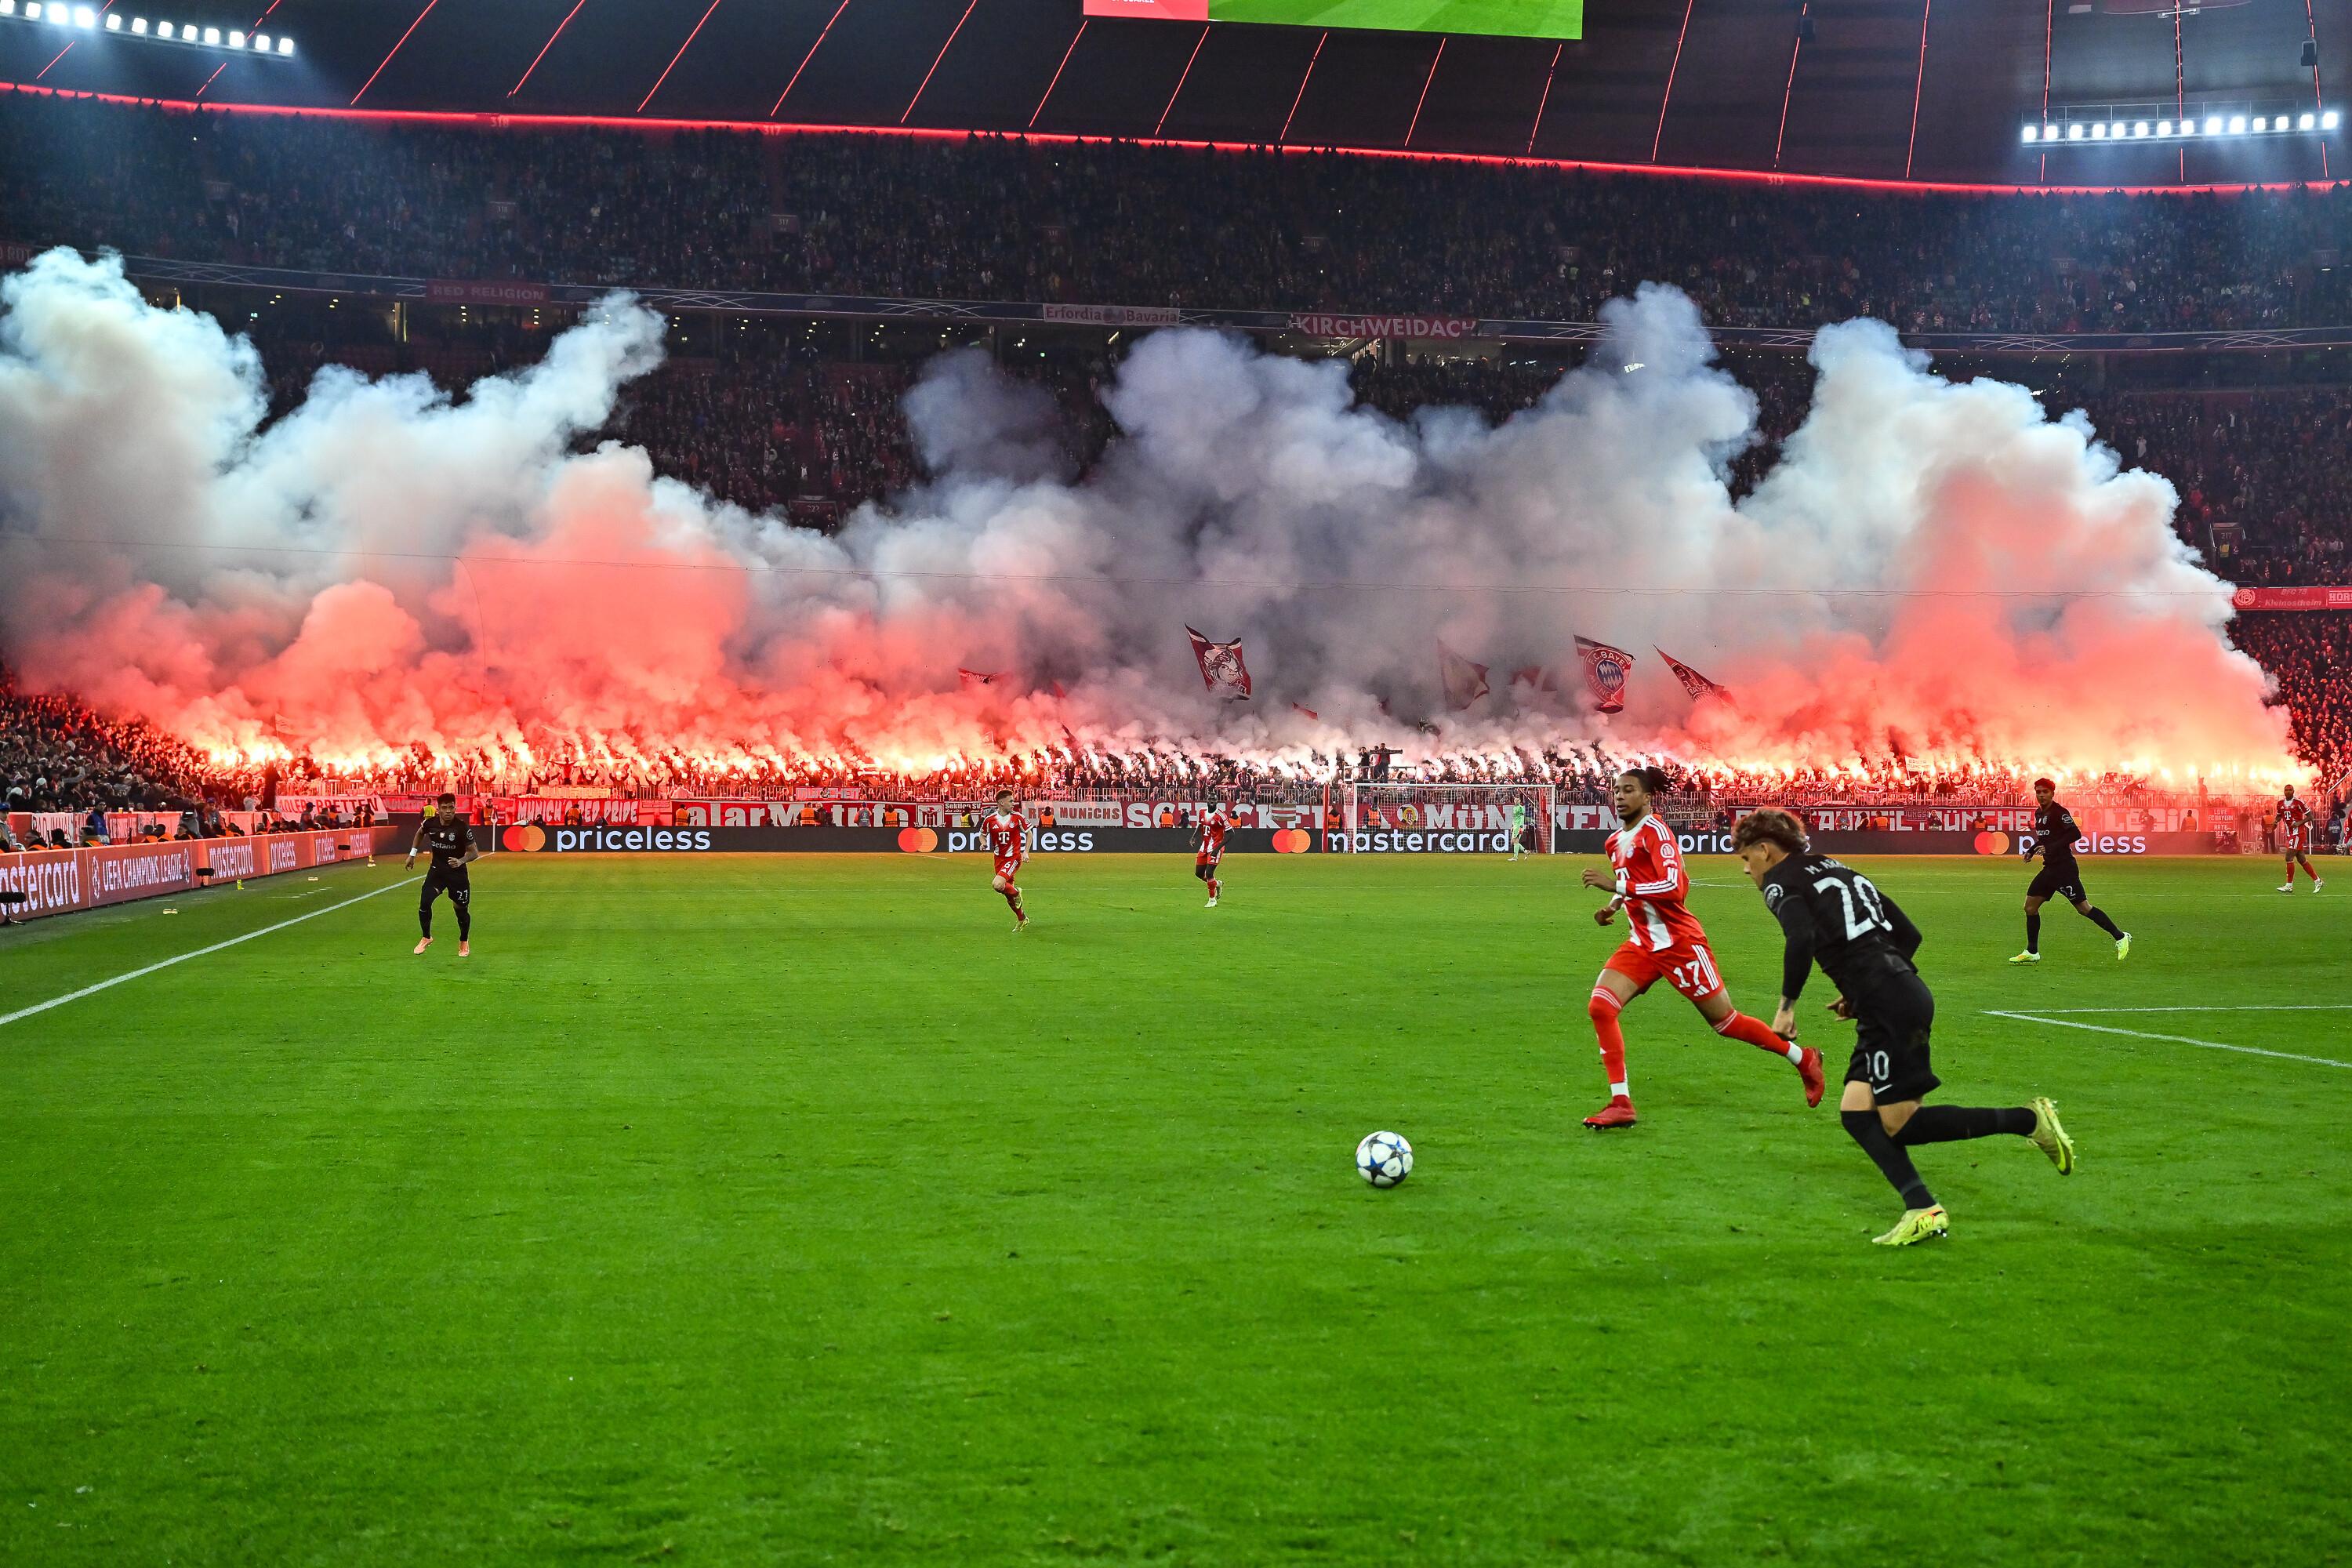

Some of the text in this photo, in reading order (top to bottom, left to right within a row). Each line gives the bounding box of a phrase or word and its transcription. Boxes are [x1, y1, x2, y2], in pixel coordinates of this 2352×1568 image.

[434, 285, 544, 300] RED RELIGION
[1045, 307, 1177, 323] Erfordia Bavaria
[2328, 593, 2352, 601] HOR
[316, 797, 379, 813] BRETTEN
[604, 800, 638, 823] PRIDE
[315, 833, 335, 866] priceless
[557, 826, 710, 852] priceless
[949, 828, 1094, 852] prieless
[1323, 829, 1509, 851] mastercard
[2019, 832, 2146, 855] peless
[209, 838, 255, 879] mastercard
[270, 833, 296, 873] priceless
[102, 853, 183, 892] UEFA CHAMPIONS LEAGUE
[1804, 865, 1822, 875] M.
[0, 850, 80, 916] astercard
[1813, 874, 1893, 941] 20
[1672, 960, 1700, 989] 17
